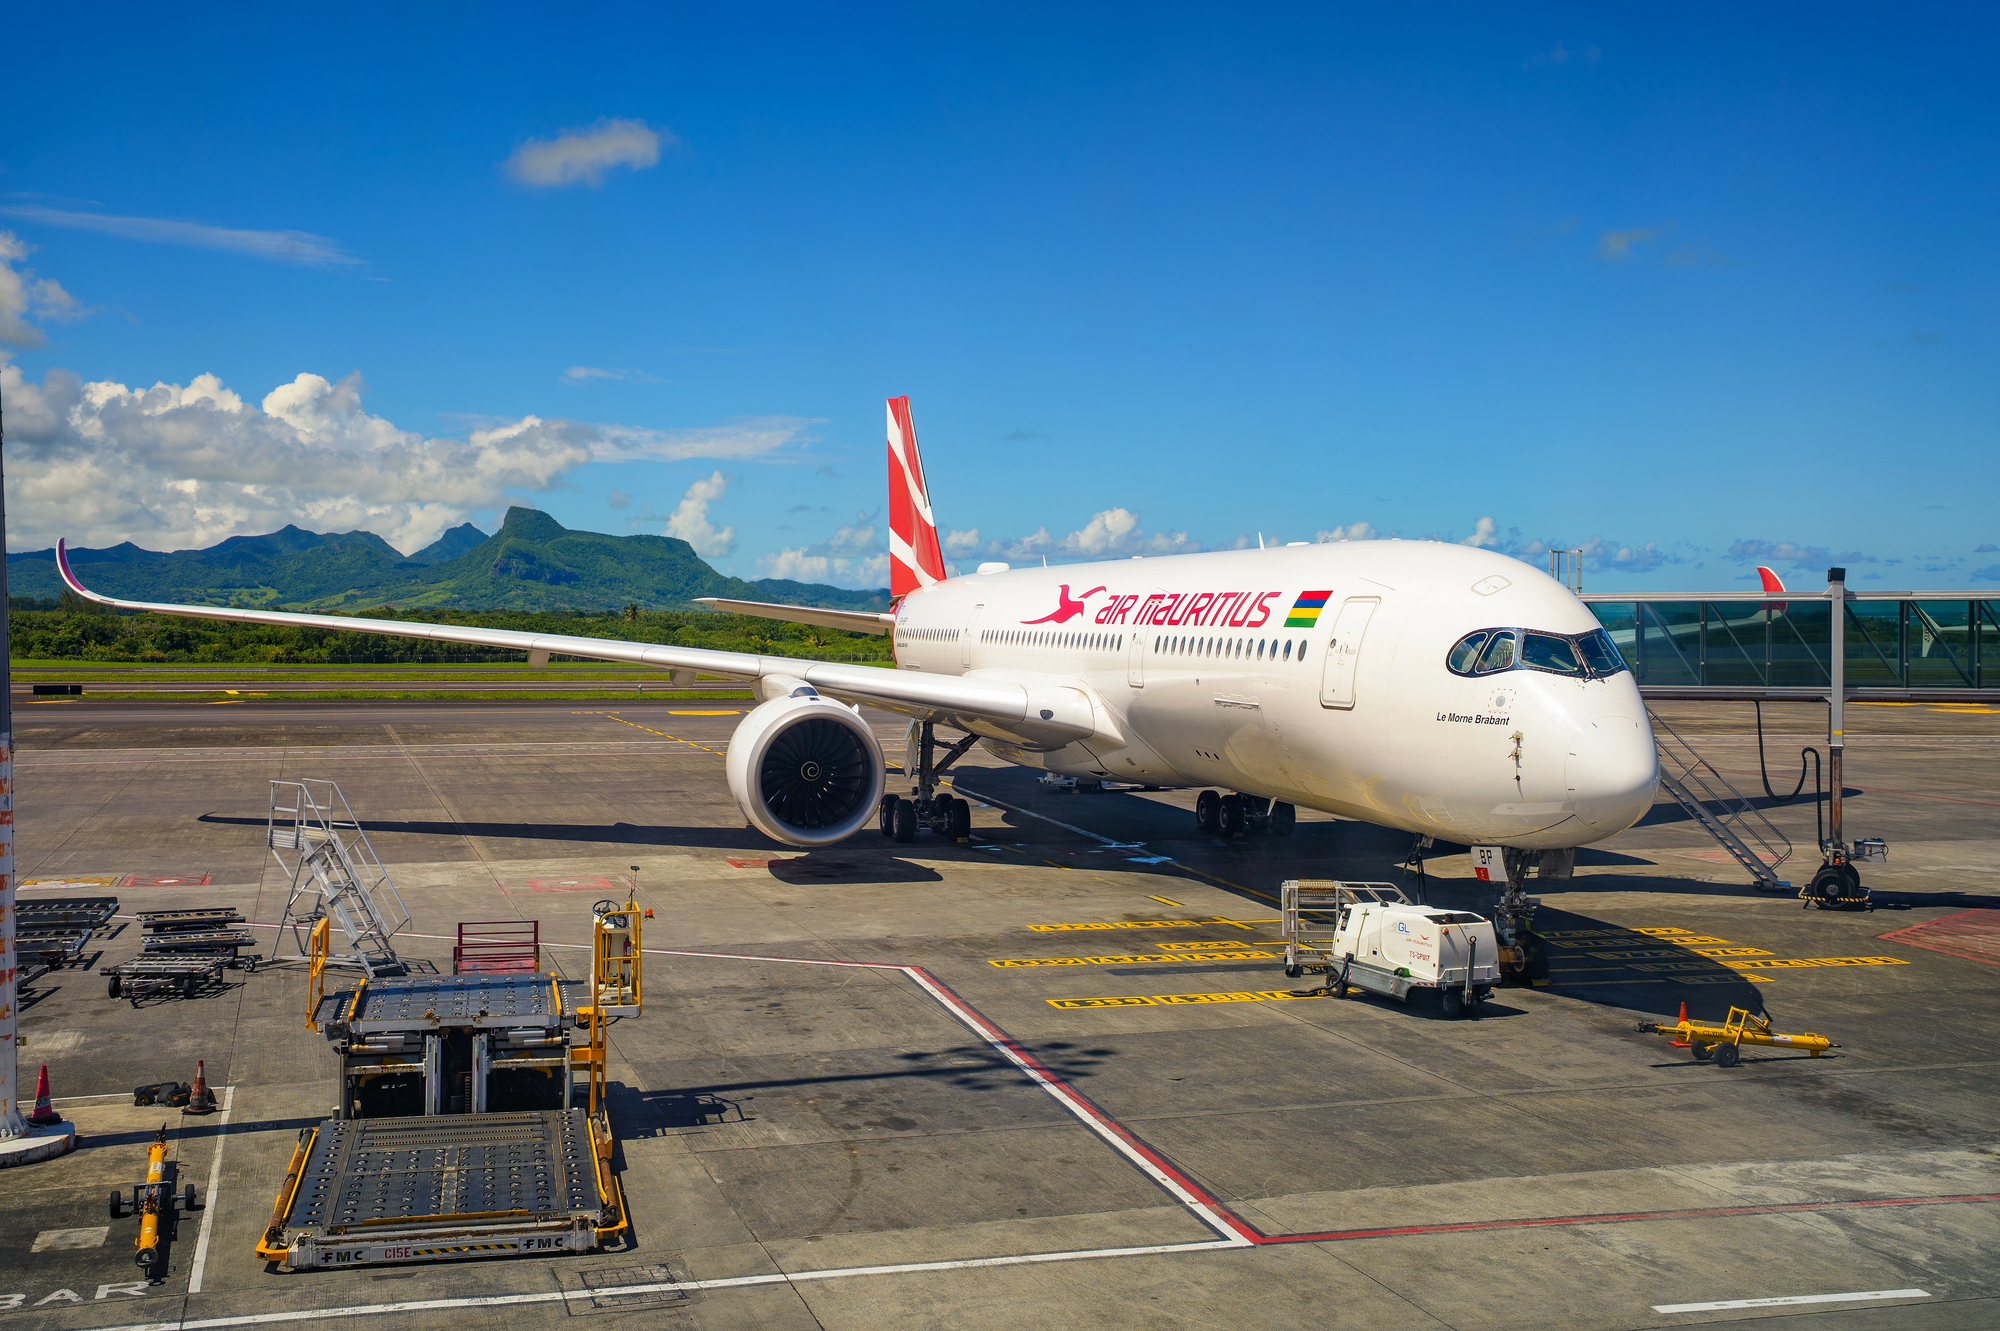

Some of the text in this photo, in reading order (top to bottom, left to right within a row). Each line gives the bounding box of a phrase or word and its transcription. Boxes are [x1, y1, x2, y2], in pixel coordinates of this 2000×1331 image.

[1436, 712, 1510, 726] Le Morne Brabant
[1480, 849, 1493, 864] BP
[1397, 921, 1410, 933] GL
[1702, 1029, 1725, 1038] CLYDE
[522, 1237, 564, 1250] FMC
[320, 1250, 363, 1264] FMC
